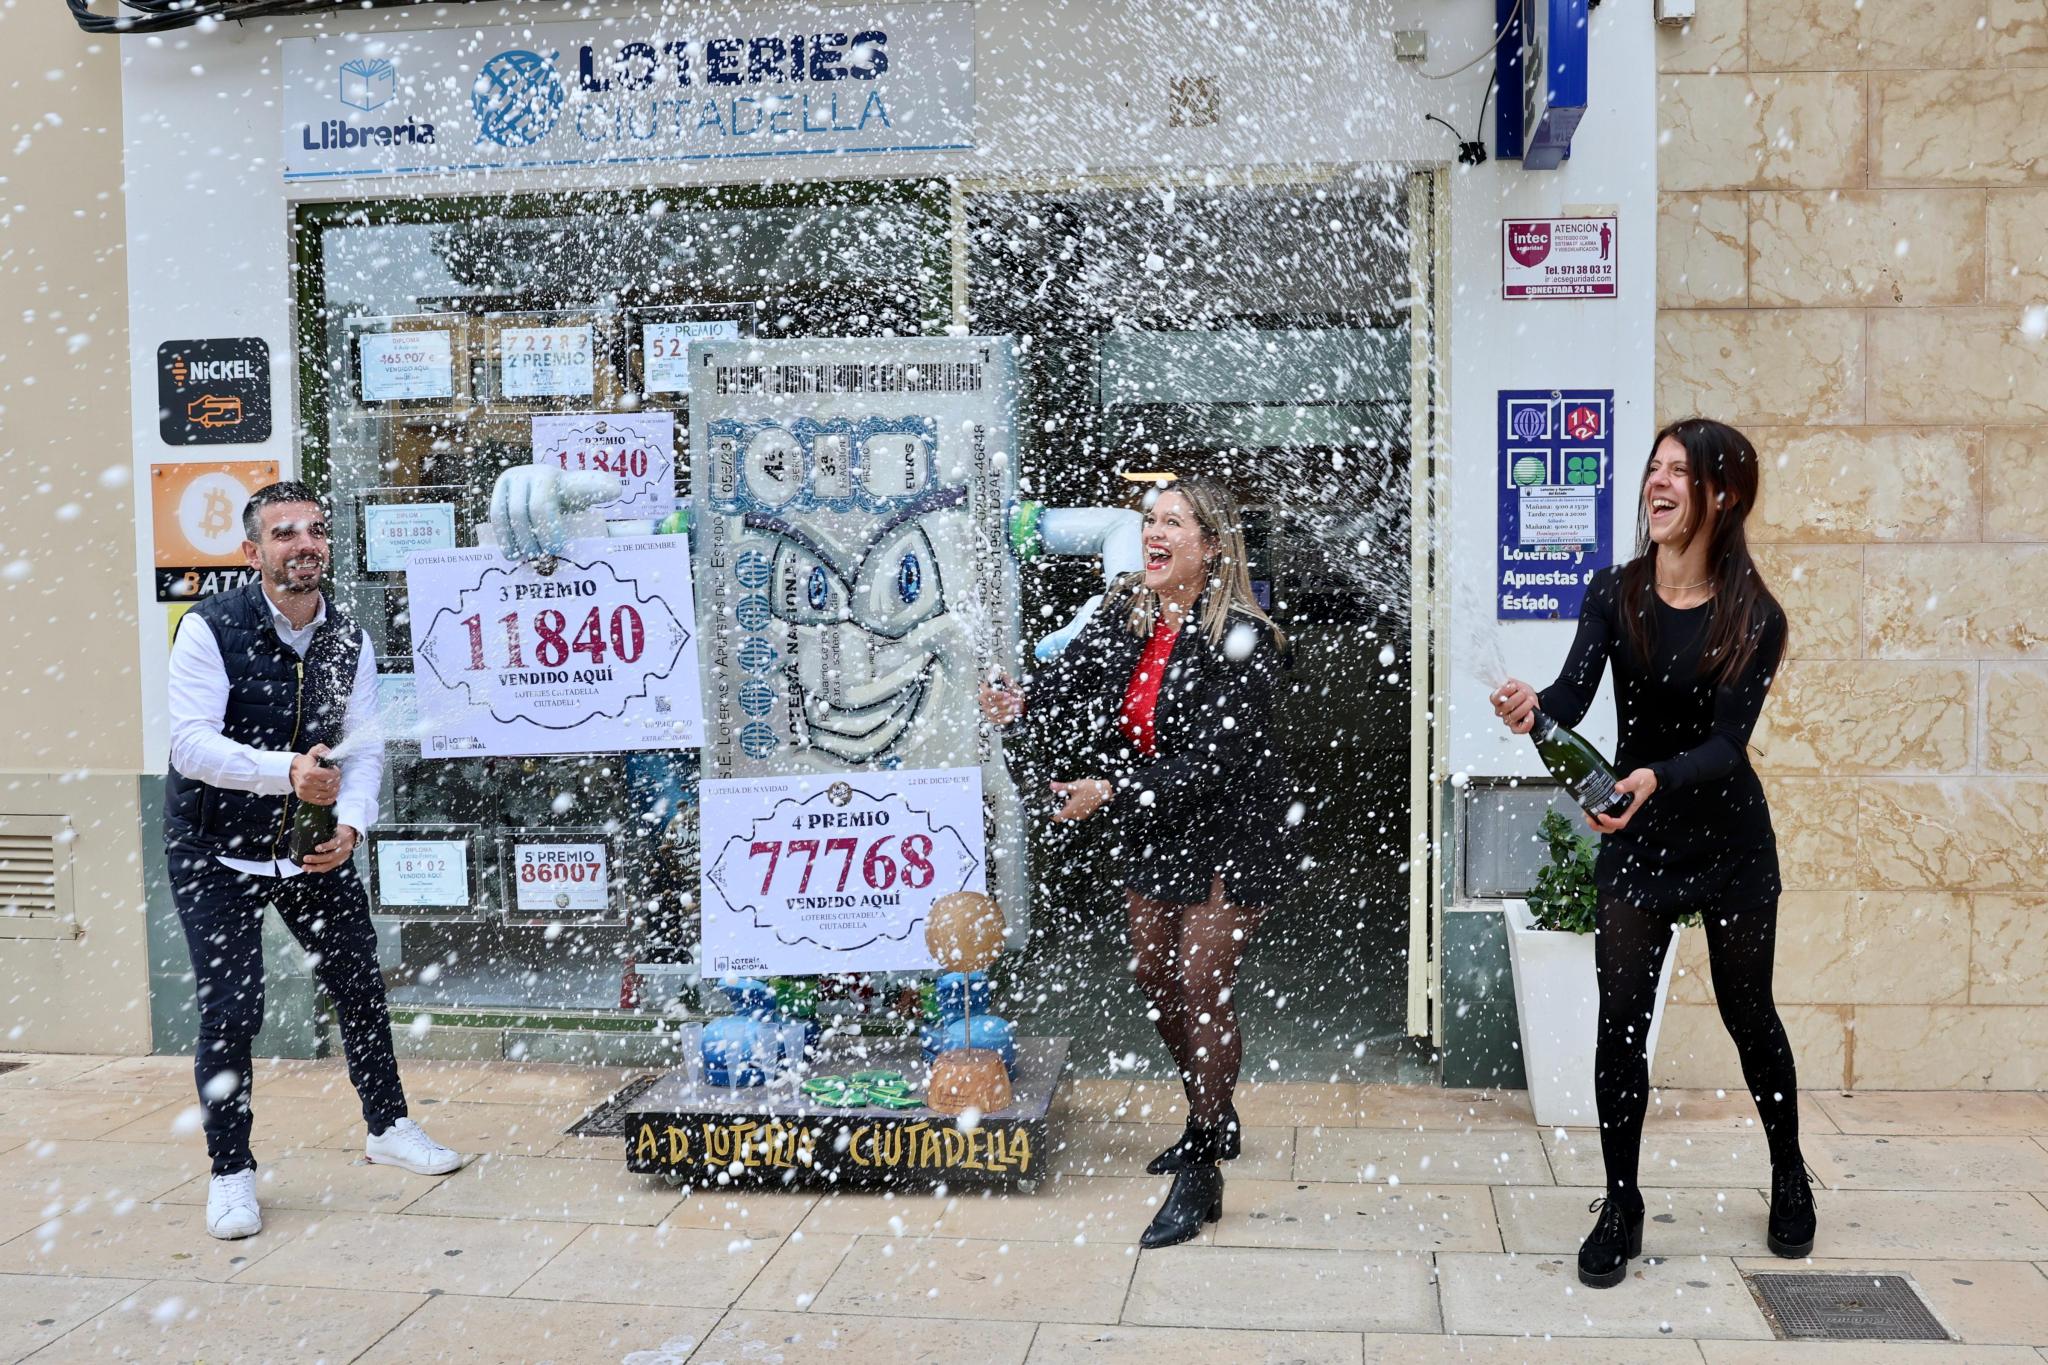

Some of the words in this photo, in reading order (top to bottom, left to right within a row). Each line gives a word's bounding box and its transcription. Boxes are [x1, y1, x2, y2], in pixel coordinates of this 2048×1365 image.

[579, 31, 889, 93] LOTERIES
[576, 92, 893, 143] CIUTADELLA
[303, 116, 435, 150] Llibreria
[1555, 221, 1599, 233] ATENCIÓN
[1514, 232, 1549, 244] intec
[1545, 266, 1559, 275] Tel.
[1561, 266, 1576, 274] 971
[1577, 266, 1588, 274] 38
[1590, 266, 1601, 274] 03
[1602, 265, 1611, 274] 12
[1545, 275, 1612, 284] inecseguridad.com
[1526, 286, 1574, 294] CONECTADA
[675, 324, 723, 337] PREMIO
[523, 352, 586, 367] PREMIO
[1571, 411, 1578, 426] 1
[1586, 410, 1596, 426] X
[585, 436, 626, 446] PREMIO
[905, 442, 914, 490] EUROS
[635, 542, 676, 550] DICIEMBRE
[414, 556, 447, 565] LOTERÍA
[460, 554, 493, 562] NAVIDAD
[1575, 550, 1585, 565] y
[1503, 570, 1578, 589] Apuestas
[514, 580, 597, 600] PREMIO
[1503, 594, 1558, 610] Estado
[460, 604, 645, 672] 11840
[498, 670, 569, 686] VENDIDO
[572, 664, 614, 686] AQUÍ
[515, 690, 550, 698] LOTERIES
[552, 688, 600, 697] CIUTADELLA
[534, 700, 580, 708] CIUTADELLA
[753, 784, 788, 792] NAVIDAD
[808, 810, 890, 829] PREMIO
[538, 850, 594, 862] PREMIO
[521, 862, 601, 882] 86007
[749, 834, 936, 896] 77768
[786, 894, 856, 910] VENDIDO
[860, 890, 901, 908] AQUÍ
[801, 913, 836, 922] LOTERIES
[819, 922, 867, 930] CIUTADELLA
[635, 1122, 694, 1166] A.D.
[848, 1120, 1031, 1172] CIUTADELLA
